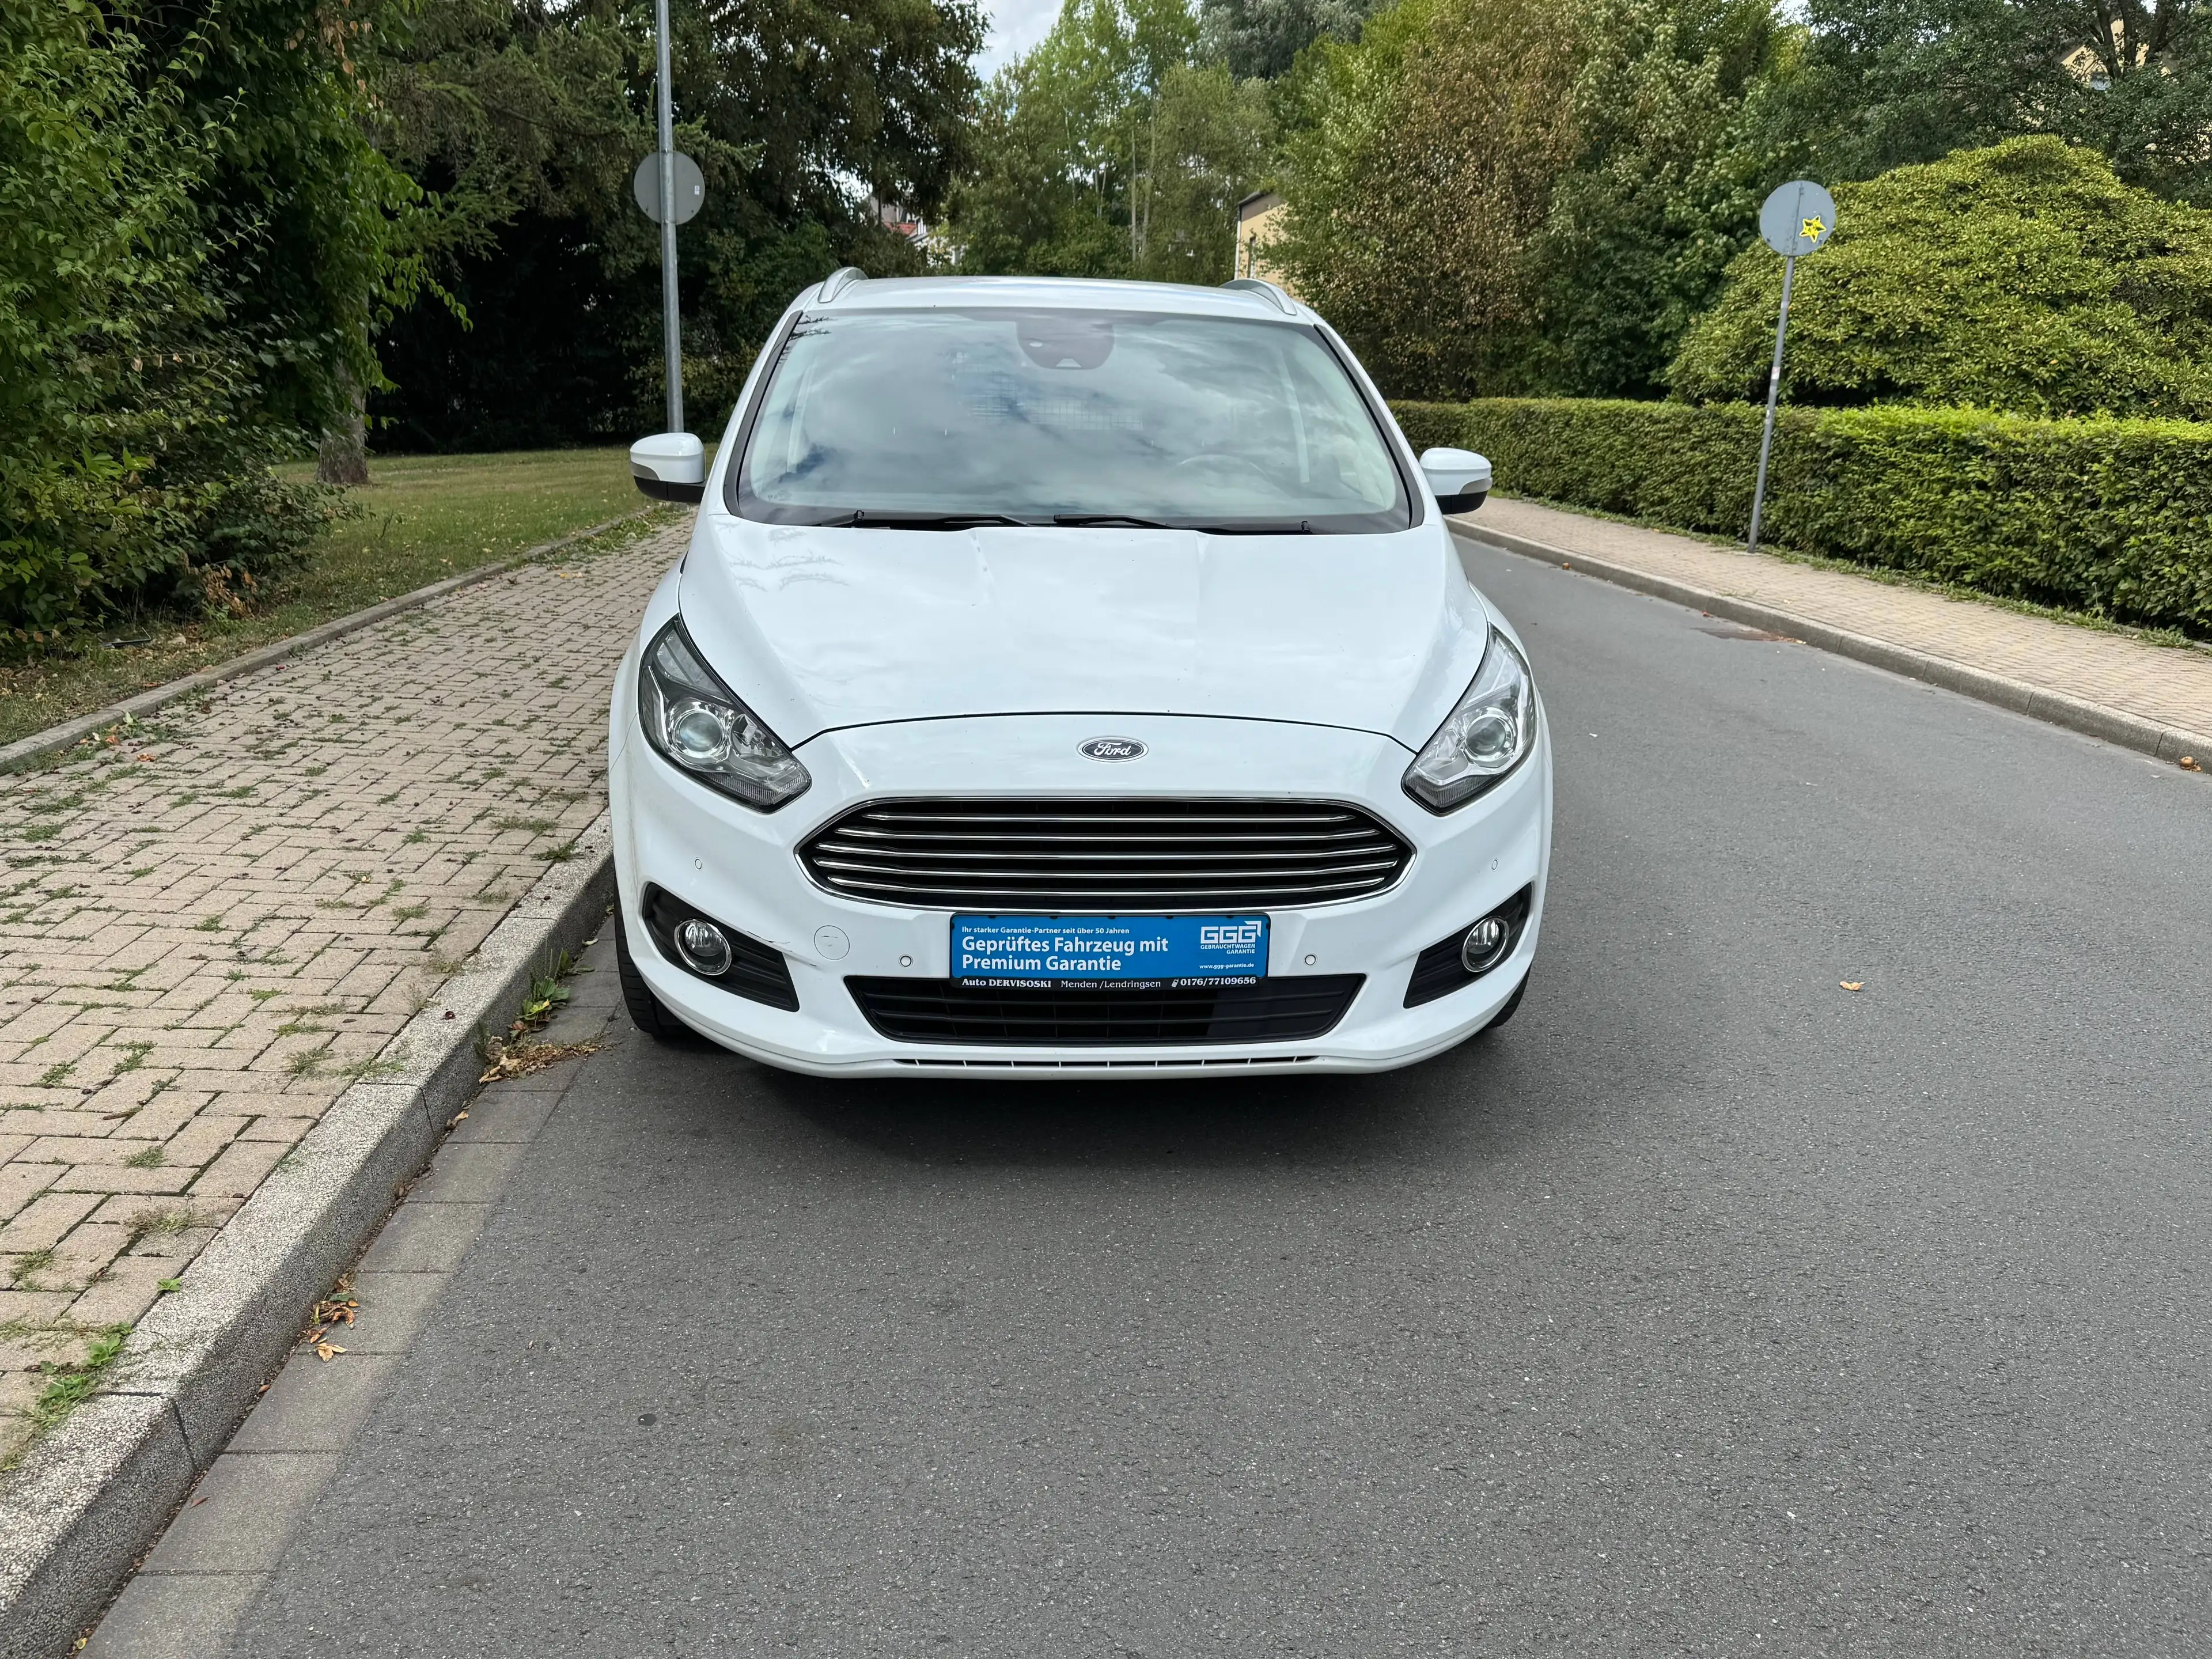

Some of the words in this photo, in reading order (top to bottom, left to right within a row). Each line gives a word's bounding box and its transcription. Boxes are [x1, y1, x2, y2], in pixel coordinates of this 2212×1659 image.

[1094, 742, 1131, 756] Ford
[1200, 925, 1256, 944] GGG
[962, 936, 1050, 955] Geprüftes
[1055, 937, 1134, 956] Fahrzeug
[1139, 937, 1168, 952] mit
[963, 955, 1041, 970] Premium
[1046, 956, 1121, 971] Garantie
[989, 979, 1051, 988] DERVISOSKI
[1180, 977, 1256, 986] 0176/77109656
